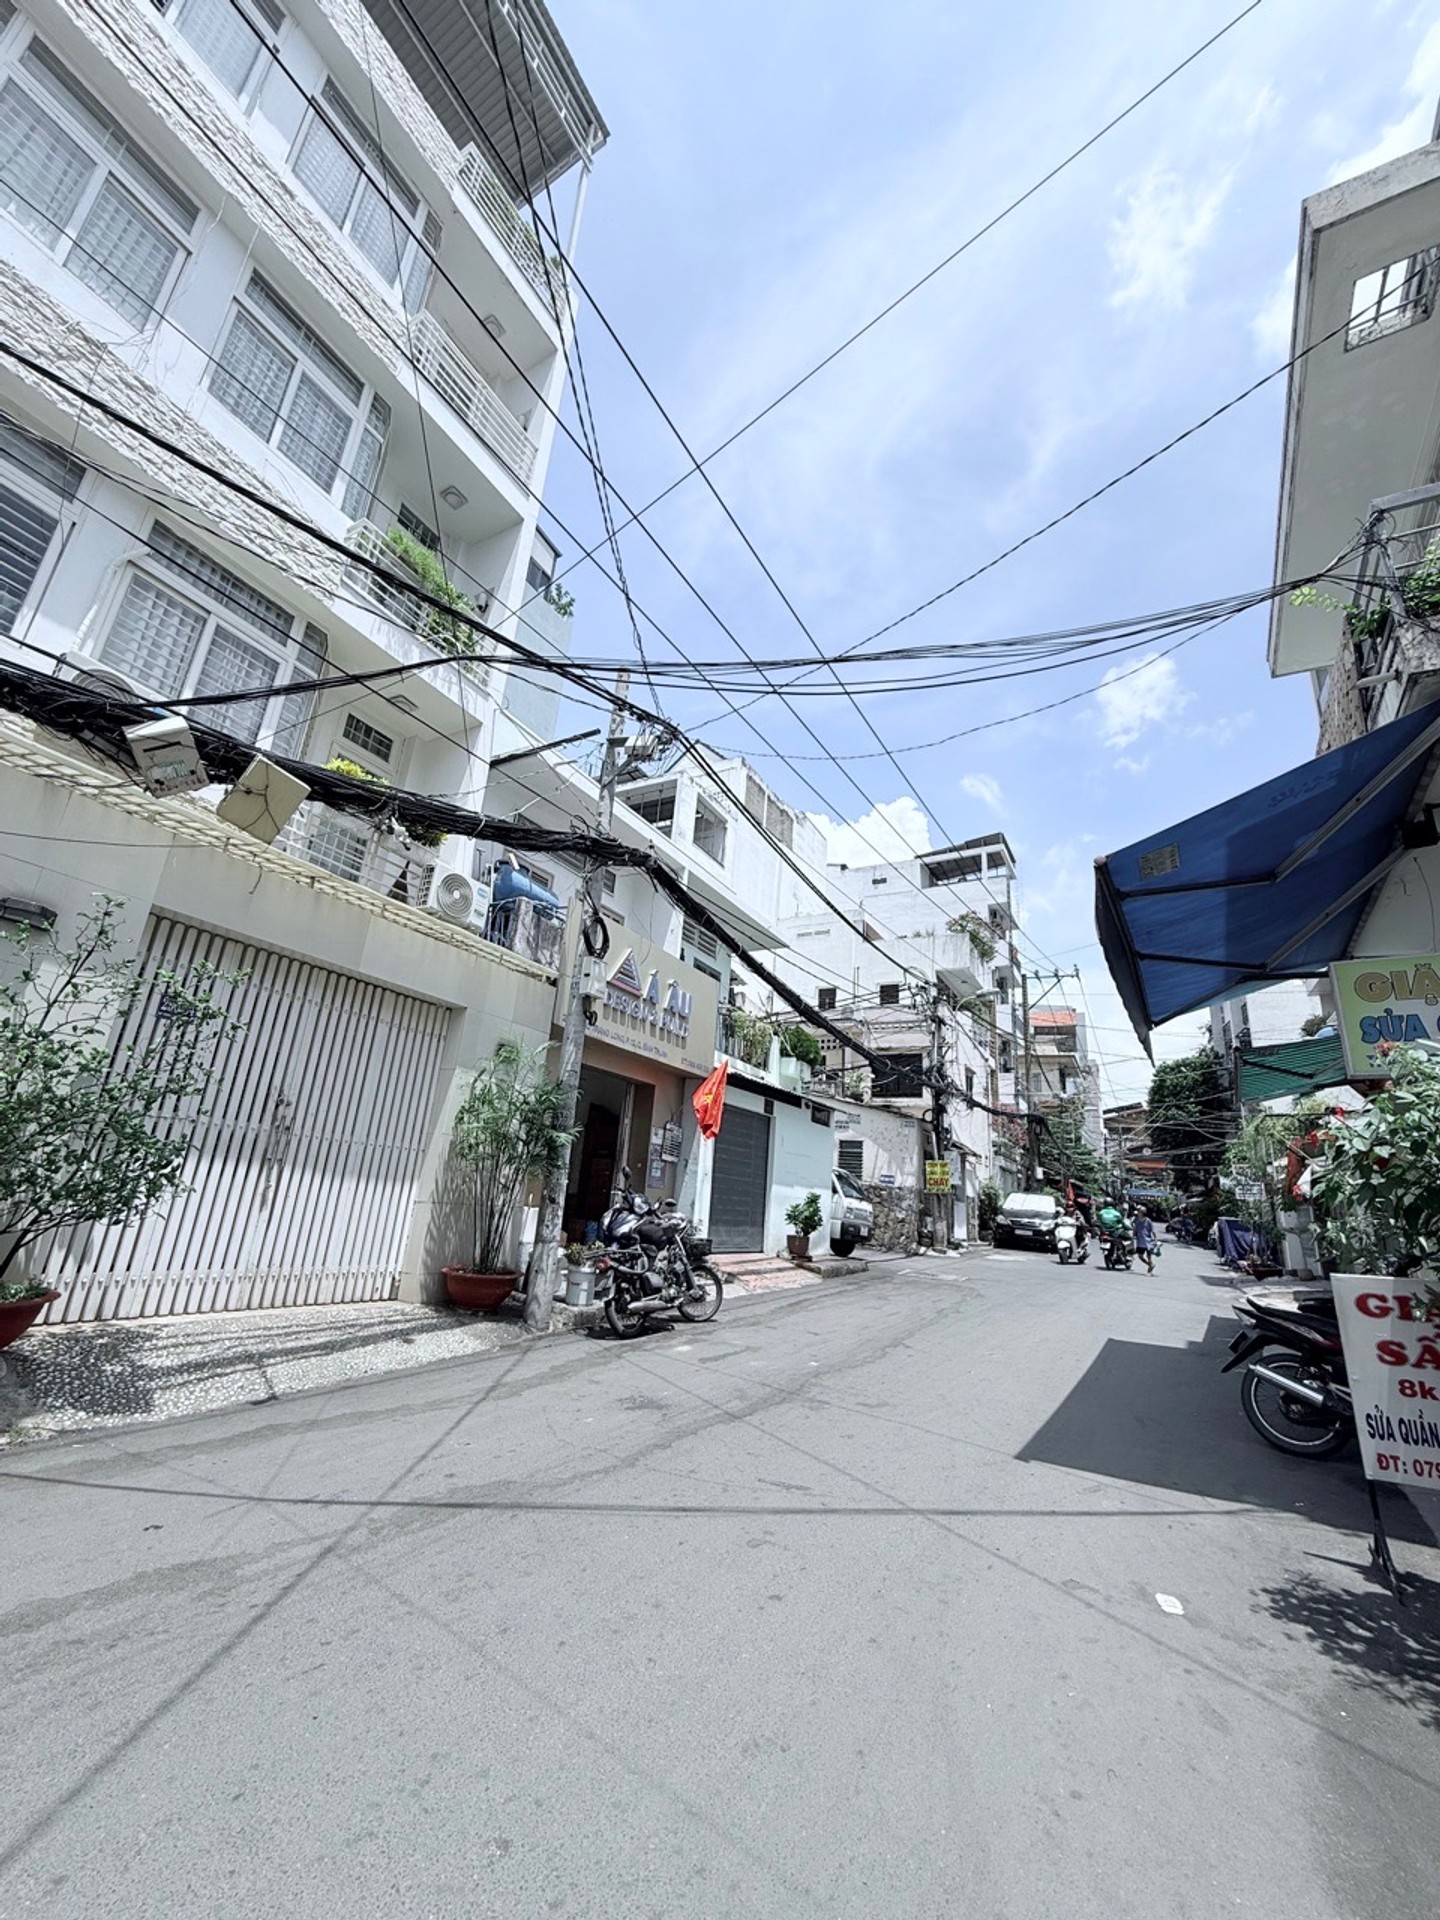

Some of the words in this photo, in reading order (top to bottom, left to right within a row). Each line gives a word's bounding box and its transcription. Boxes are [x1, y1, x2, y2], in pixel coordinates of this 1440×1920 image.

[604, 988, 648, 1021] DESIGN
[659, 1012, 689, 1038] BUILD
[1359, 1008, 1431, 1044] SỬA
[1365, 1404, 1397, 1443] SỬA
[1400, 1409, 1440, 1449] QUẦN
[1376, 1453, 1408, 1474] ĐT:
